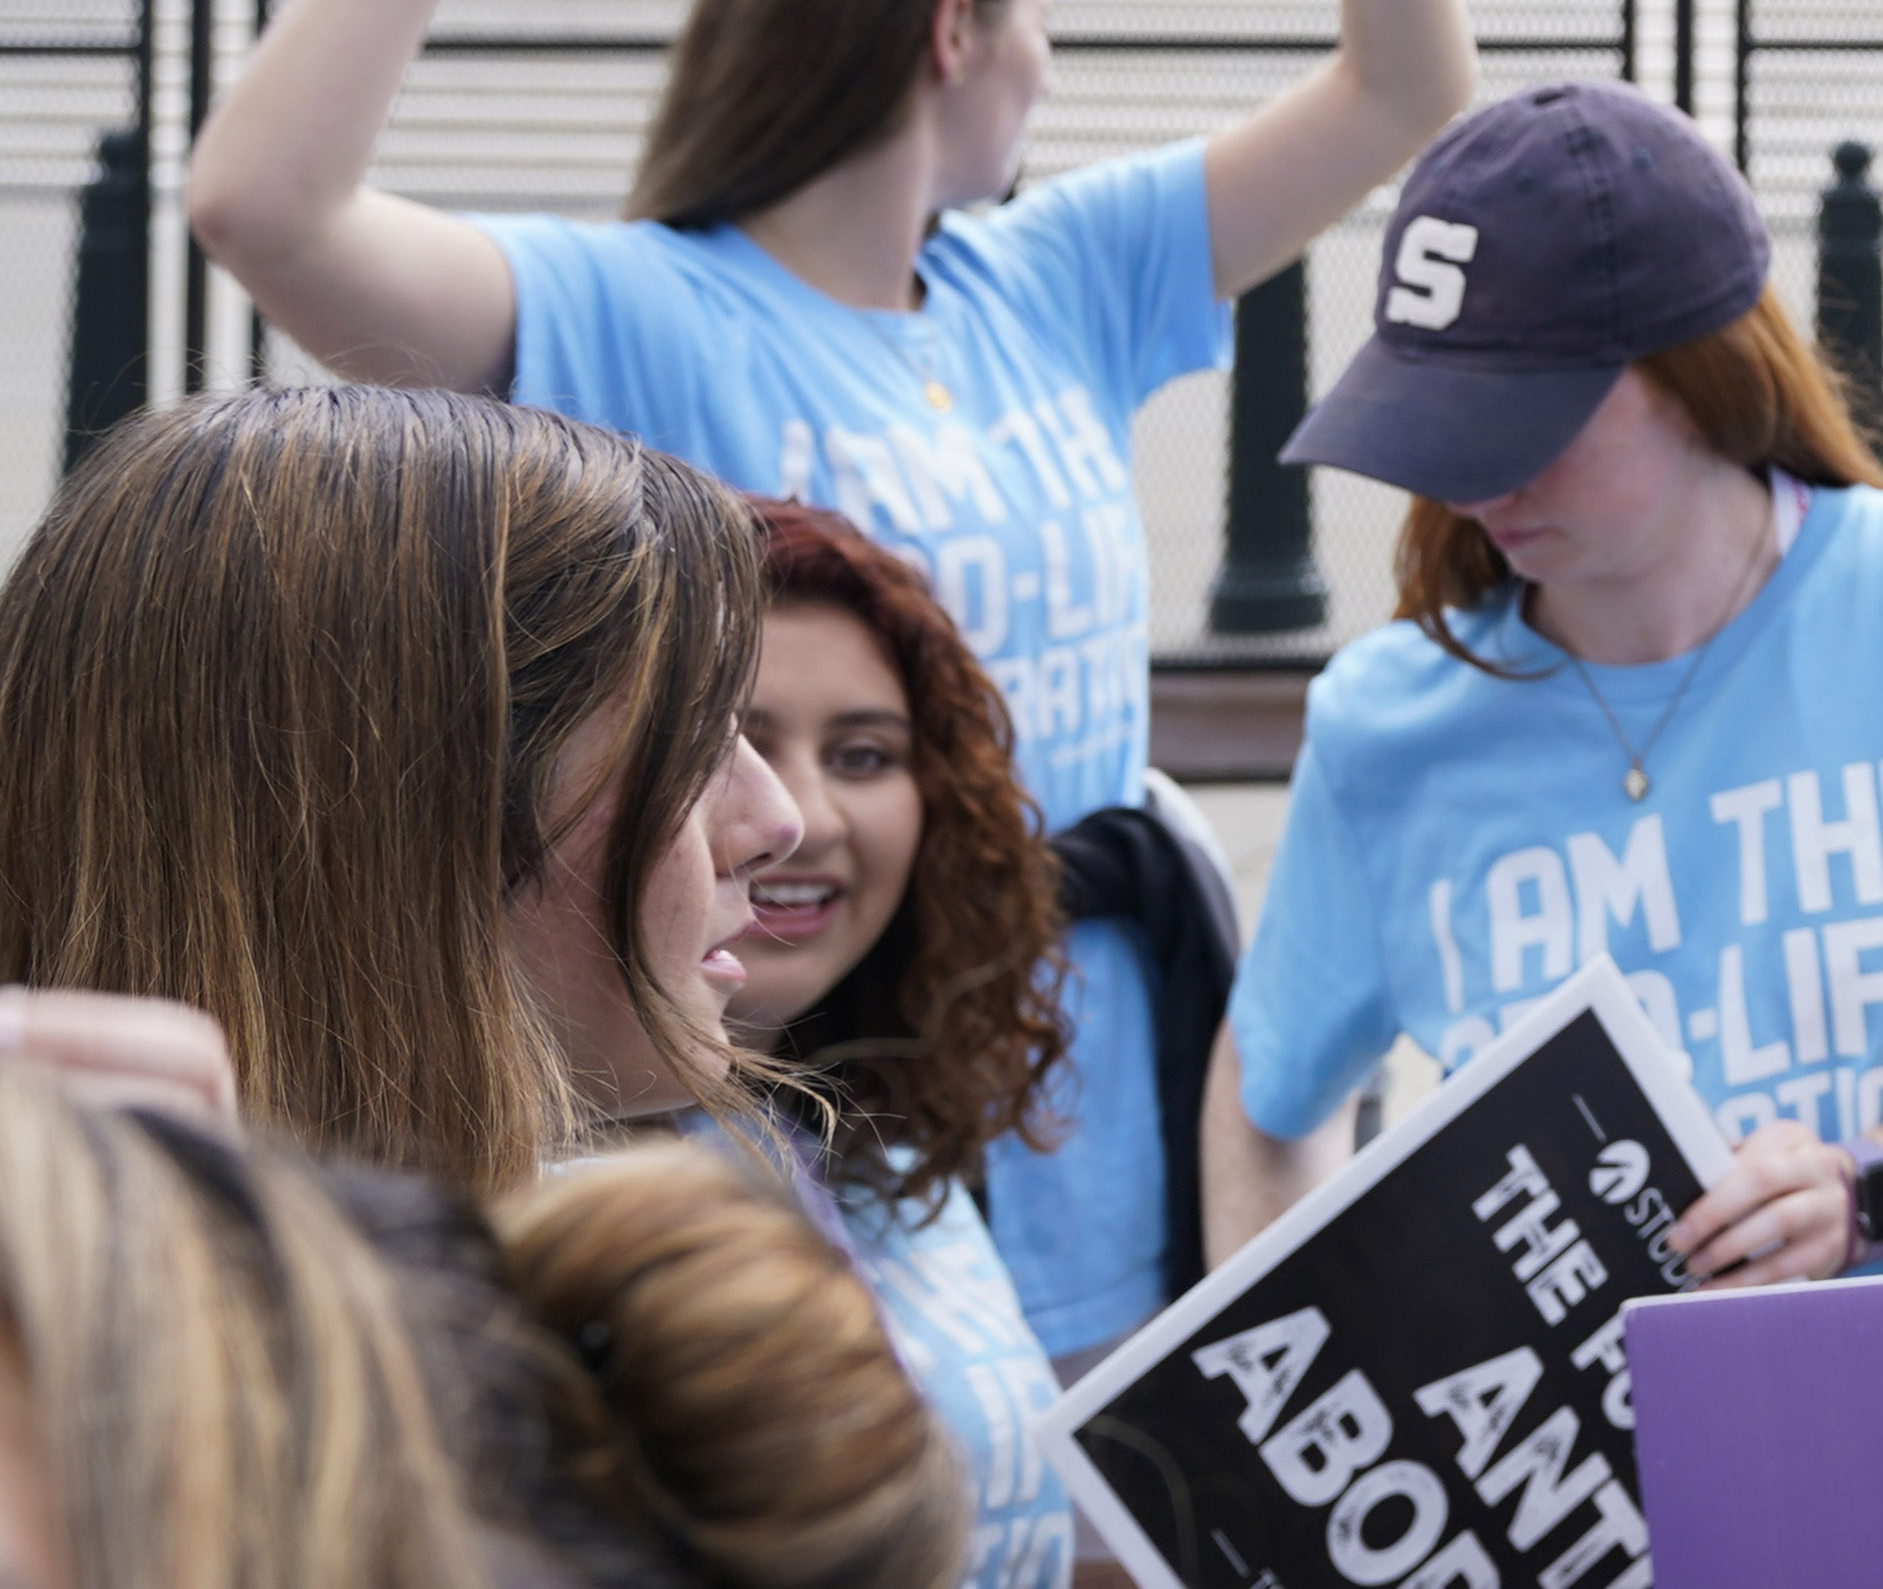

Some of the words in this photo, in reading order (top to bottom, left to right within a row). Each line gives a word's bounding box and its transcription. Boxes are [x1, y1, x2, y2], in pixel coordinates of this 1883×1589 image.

[1385, 215, 1478, 331] S
[990, 385, 1127, 508] TH
[1429, 878, 1465, 1014] I
[1487, 813, 1682, 994] AM
[1471, 1142, 1609, 1328] THE
[1570, 1310, 1636, 1431] FU
[1624, 1187, 1703, 1292] STUD
